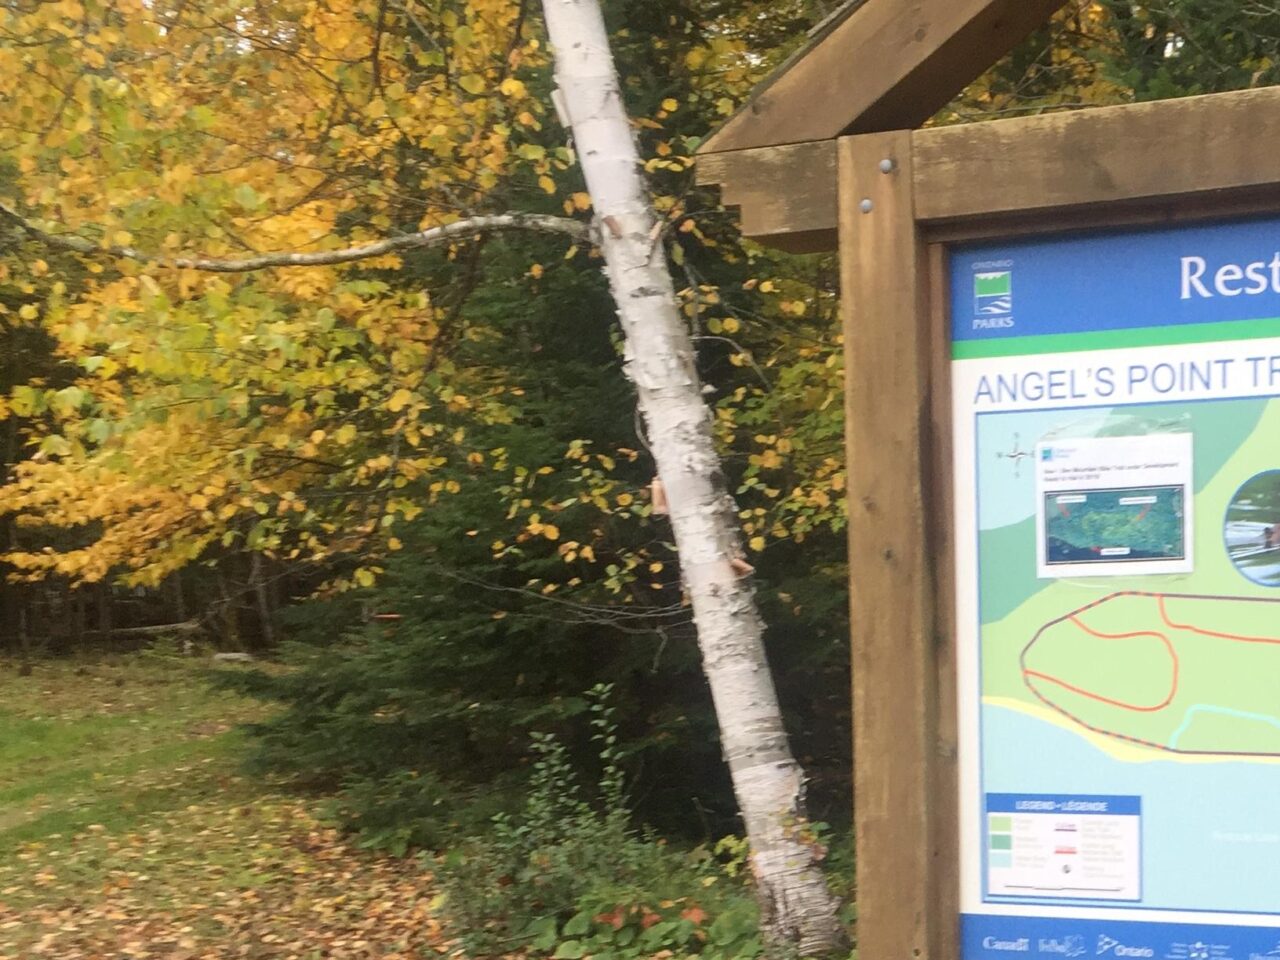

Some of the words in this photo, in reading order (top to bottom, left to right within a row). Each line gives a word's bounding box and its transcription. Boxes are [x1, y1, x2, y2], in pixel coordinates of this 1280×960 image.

[972, 316, 1015, 330] PARKS
[973, 366, 1116, 405] ANGEL'S
[1127, 358, 1236, 395] POINT
